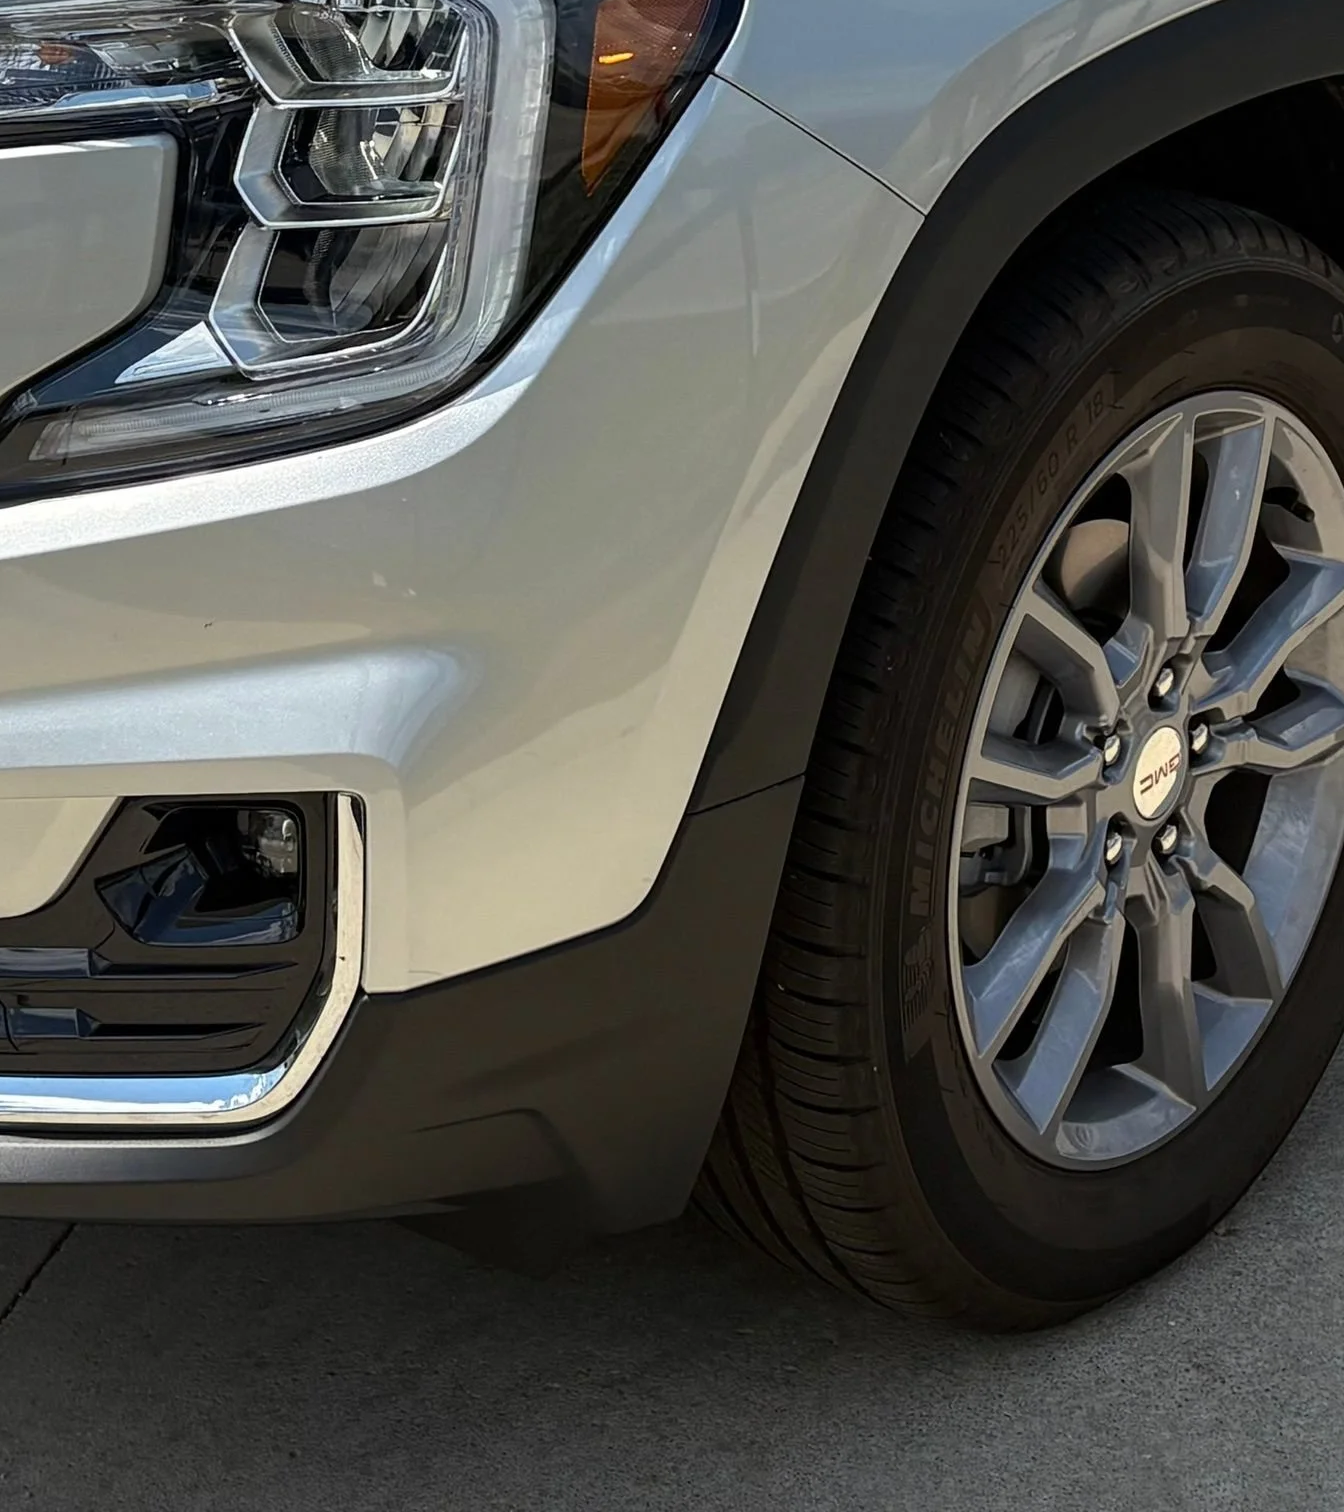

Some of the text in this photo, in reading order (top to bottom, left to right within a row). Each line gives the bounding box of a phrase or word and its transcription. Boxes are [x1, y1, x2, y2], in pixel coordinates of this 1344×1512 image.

[998, 450, 1059, 574] 225/60
[909, 611, 987, 918] MICHELIN
[1139, 753, 1182, 796] GMC
